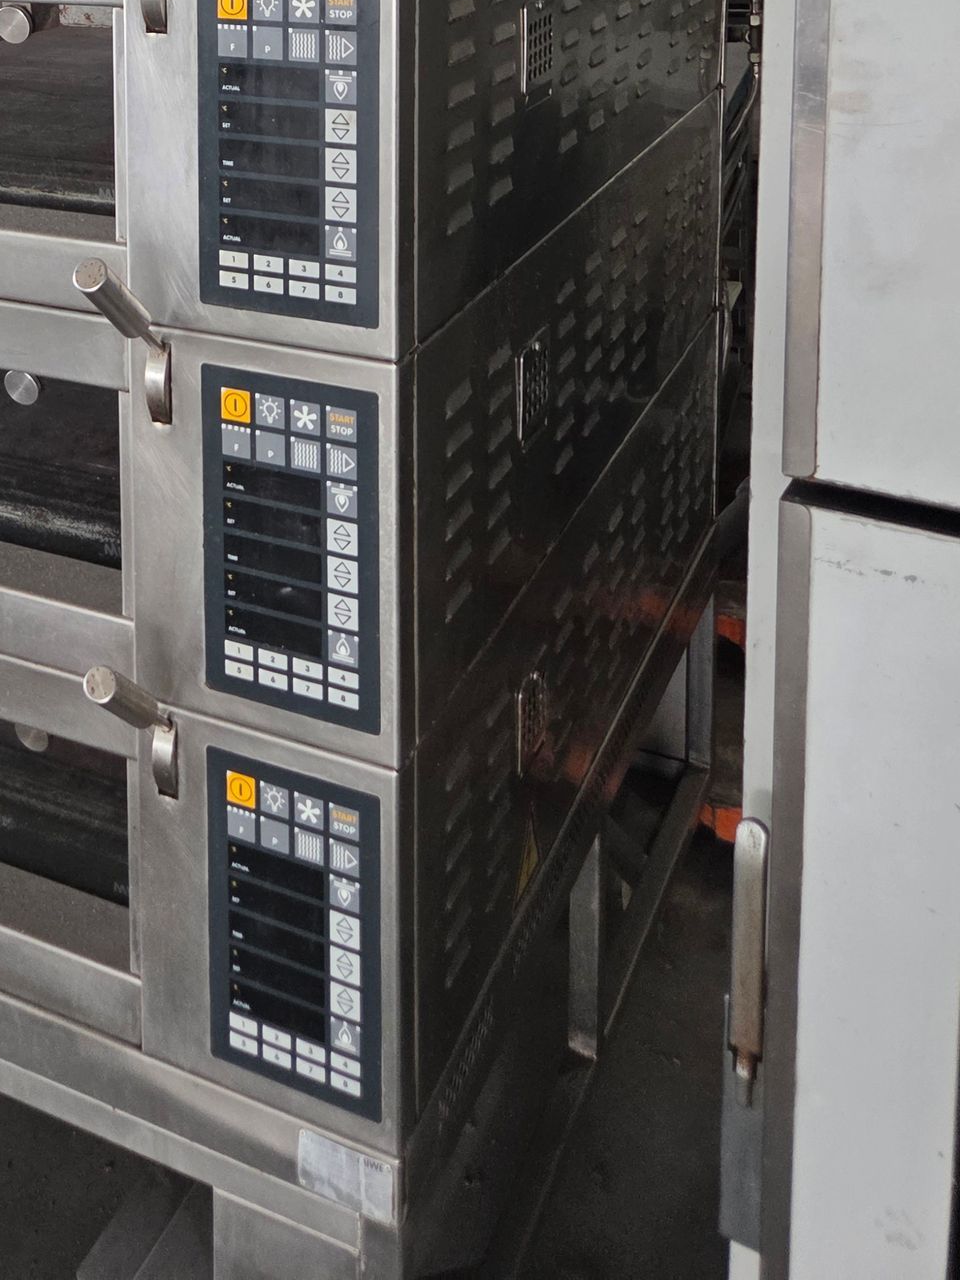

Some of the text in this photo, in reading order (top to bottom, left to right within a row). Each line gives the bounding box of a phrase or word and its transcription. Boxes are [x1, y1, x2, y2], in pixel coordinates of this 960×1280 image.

[330, 10, 352, 18] STOP
[230, 43, 235, 51] F
[265, 45, 271, 53] P
[266, 260, 271, 268] 2
[338, 291, 343, 299] 8
[329, 412, 354, 424] START
[331, 425, 353, 435] STOP
[334, 822, 356, 834] STOP
